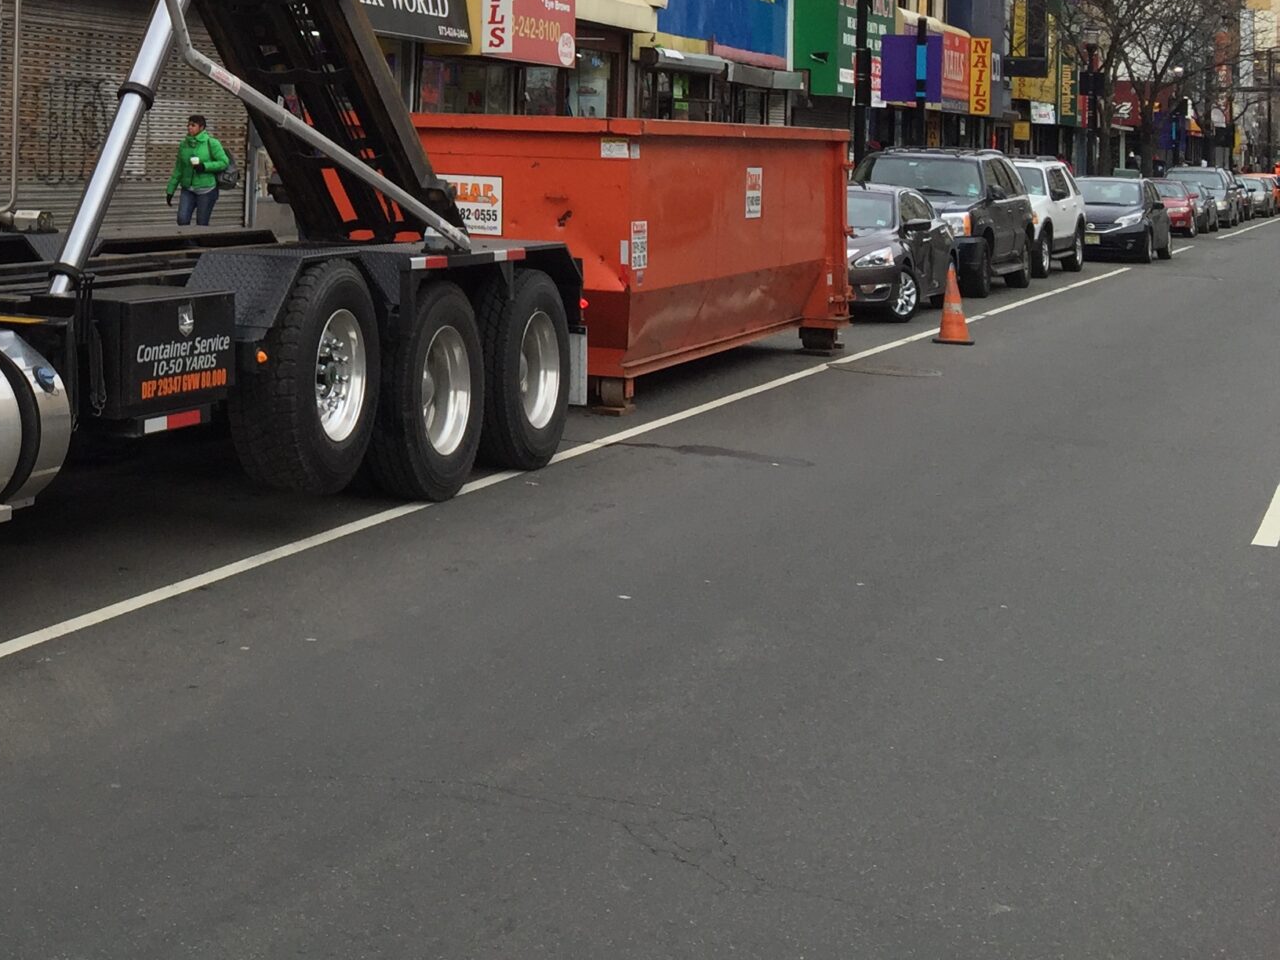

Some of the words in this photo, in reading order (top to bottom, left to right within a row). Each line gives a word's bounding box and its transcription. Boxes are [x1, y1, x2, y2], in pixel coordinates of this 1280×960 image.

[973, 40, 990, 113] NAILS
[136, 340, 192, 363] Container
[193, 333, 230, 355] Service
[152, 358, 183, 377] 10-50
[185, 354, 217, 371] YARDS
